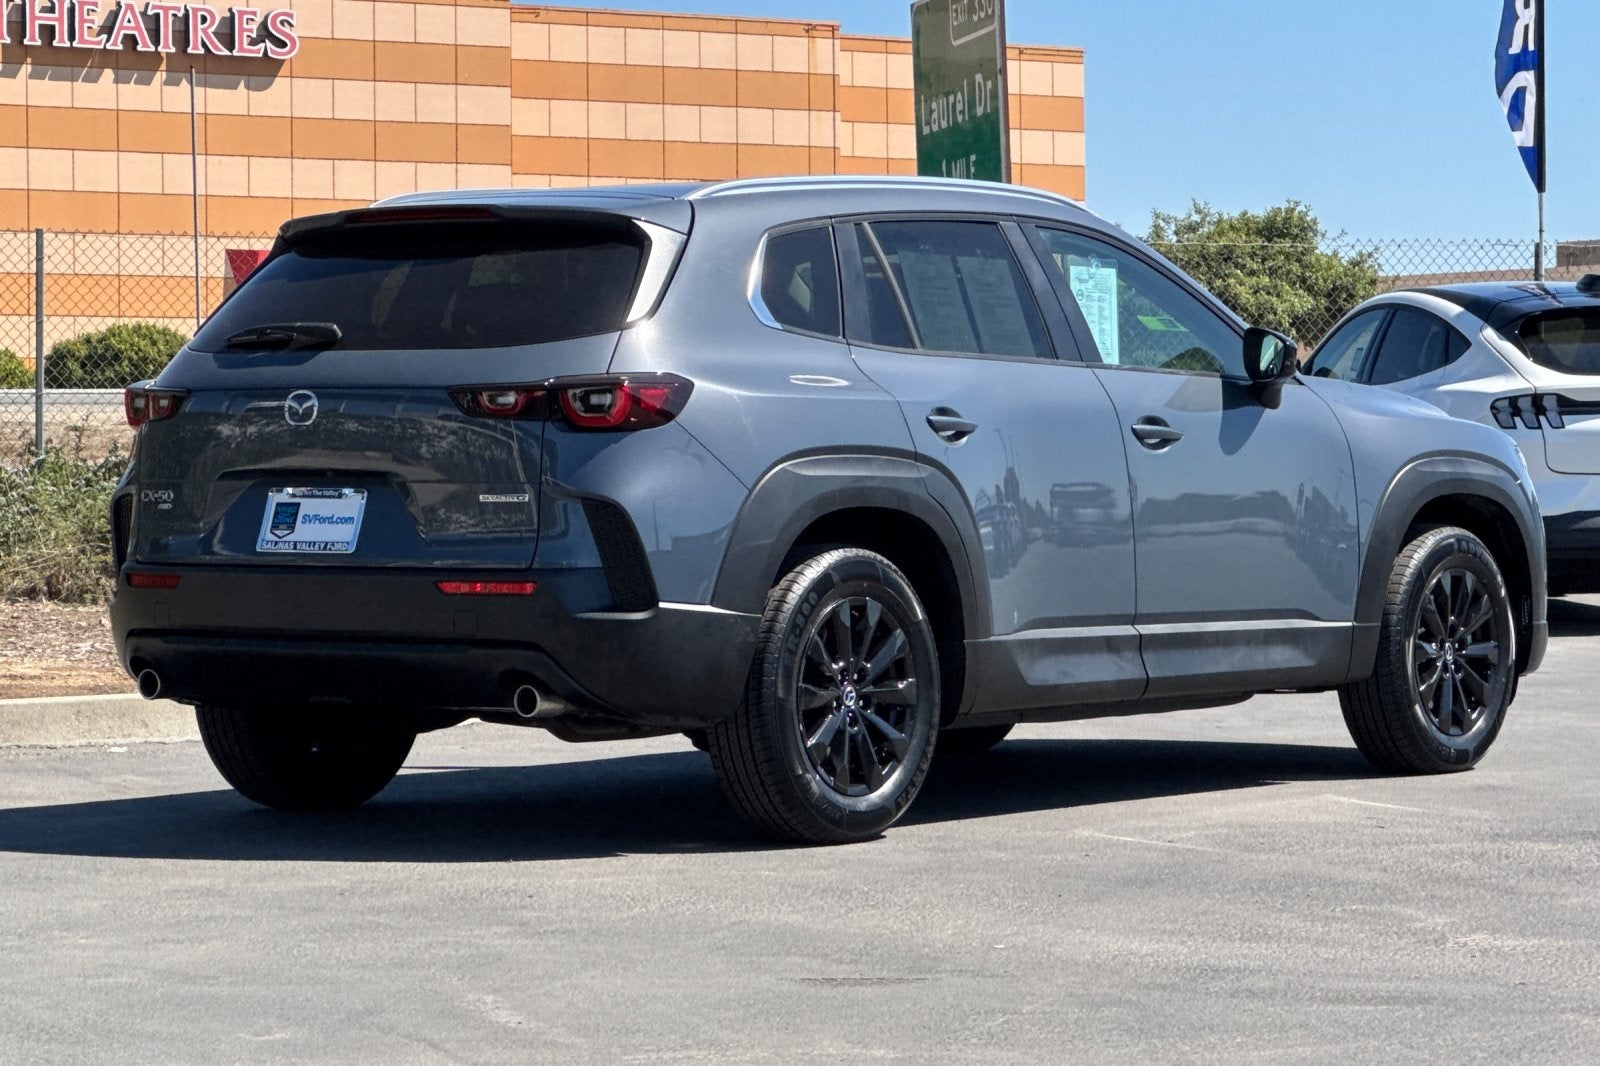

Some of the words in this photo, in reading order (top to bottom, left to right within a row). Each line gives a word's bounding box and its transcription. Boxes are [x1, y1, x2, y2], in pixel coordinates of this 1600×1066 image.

[952, 0, 968, 26] EXIT
[920, 77, 969, 136] Laurel
[975, 72, 993, 118] Dr
[141, 489, 174, 502] CX-50
[301, 513, 355, 525] SVFord.com
[262, 541, 295, 550] SALINAS
[296, 541, 325, 551] VALLEY
[326, 542, 348, 551] FORD
